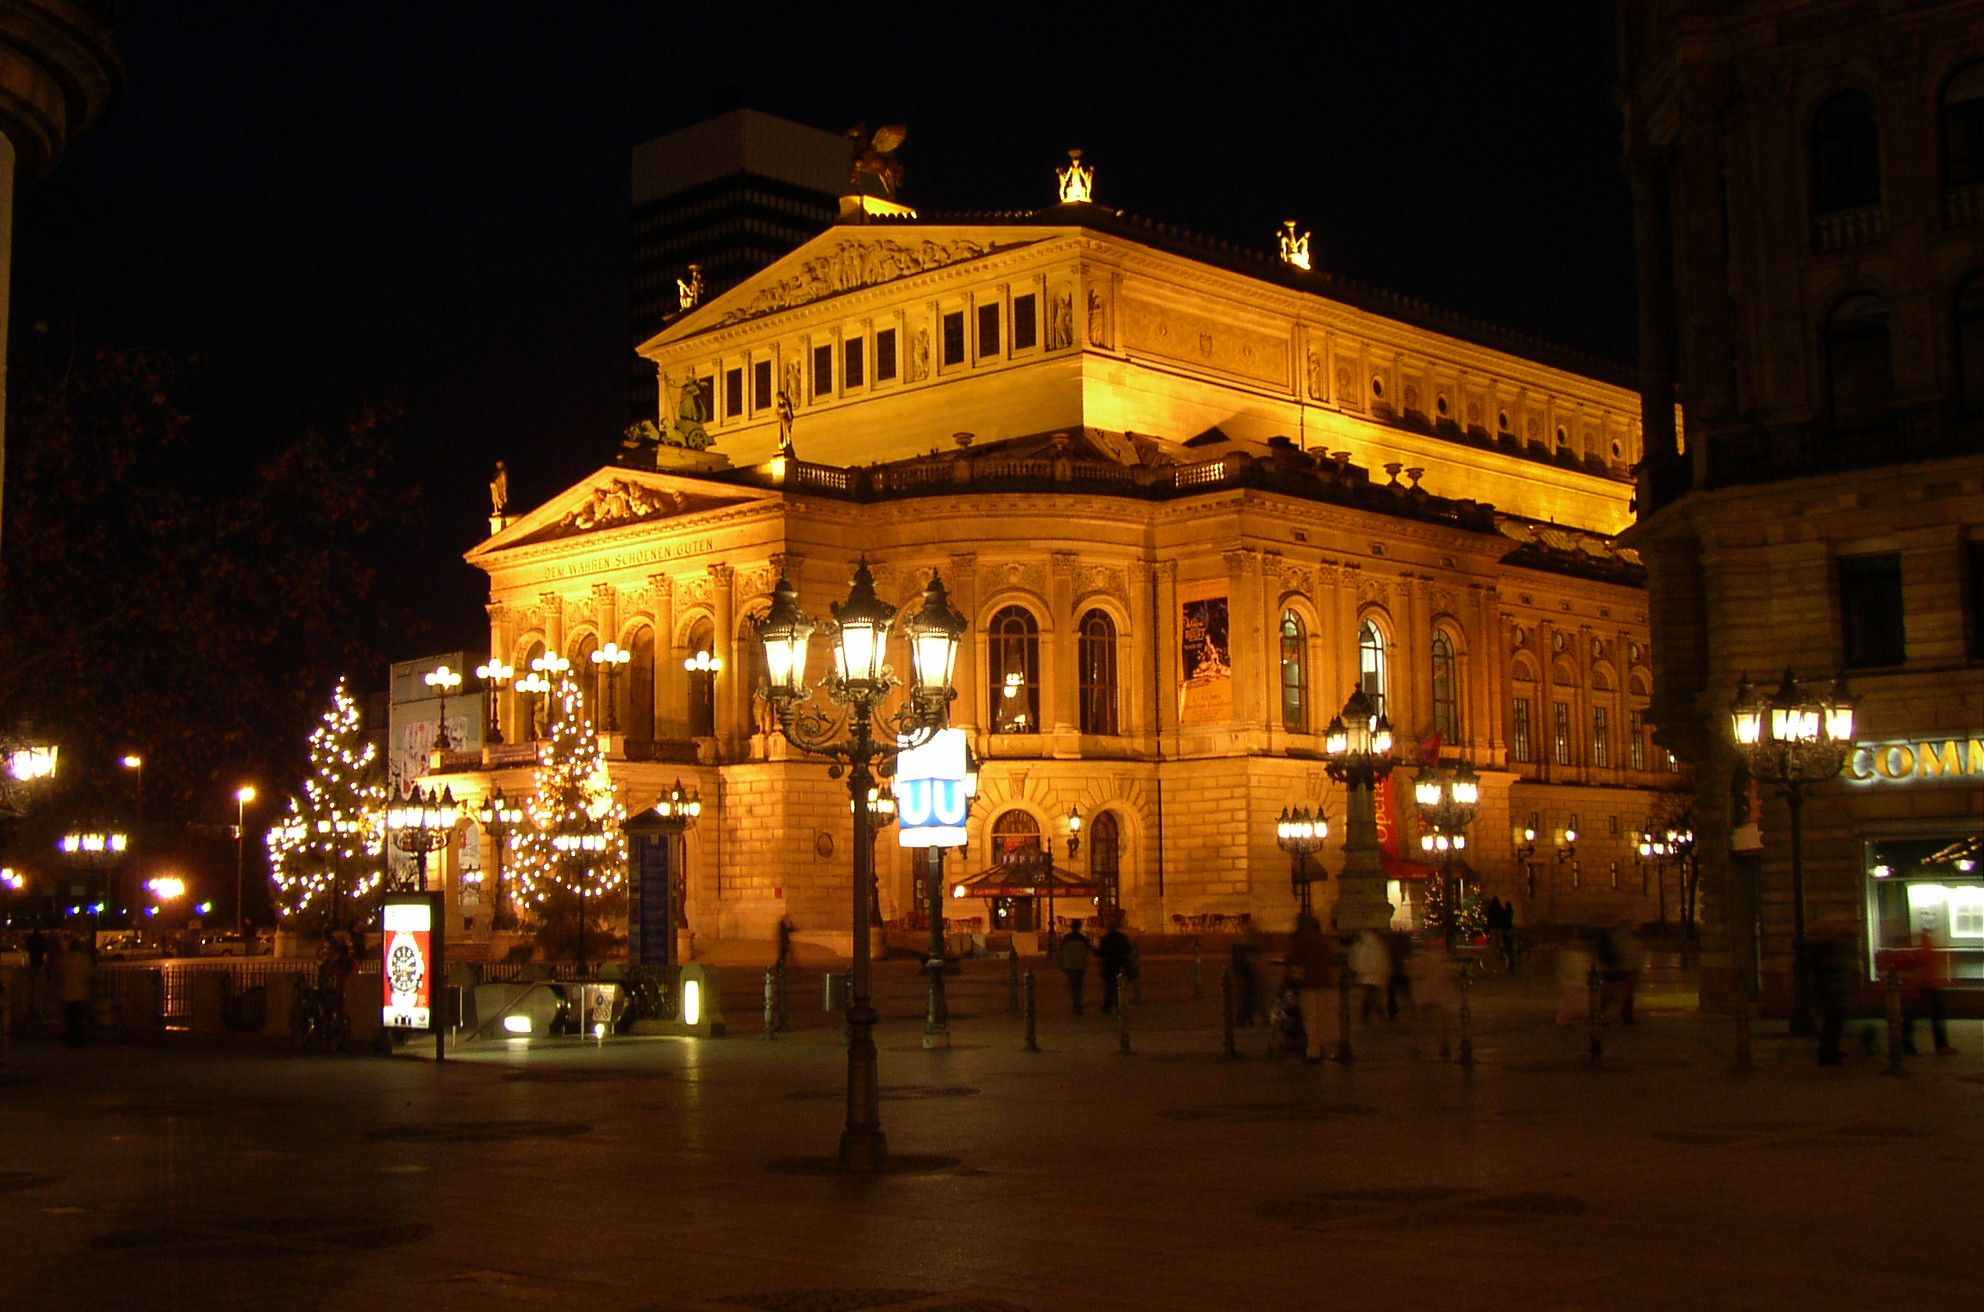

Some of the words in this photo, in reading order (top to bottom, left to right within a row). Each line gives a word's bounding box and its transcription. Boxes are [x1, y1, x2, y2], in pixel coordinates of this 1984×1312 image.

[544, 566, 564, 579] DEM
[568, 557, 610, 575] WAHREN
[615, 546, 671, 566] SCHOENEN
[676, 538, 713, 556] GUTEN
